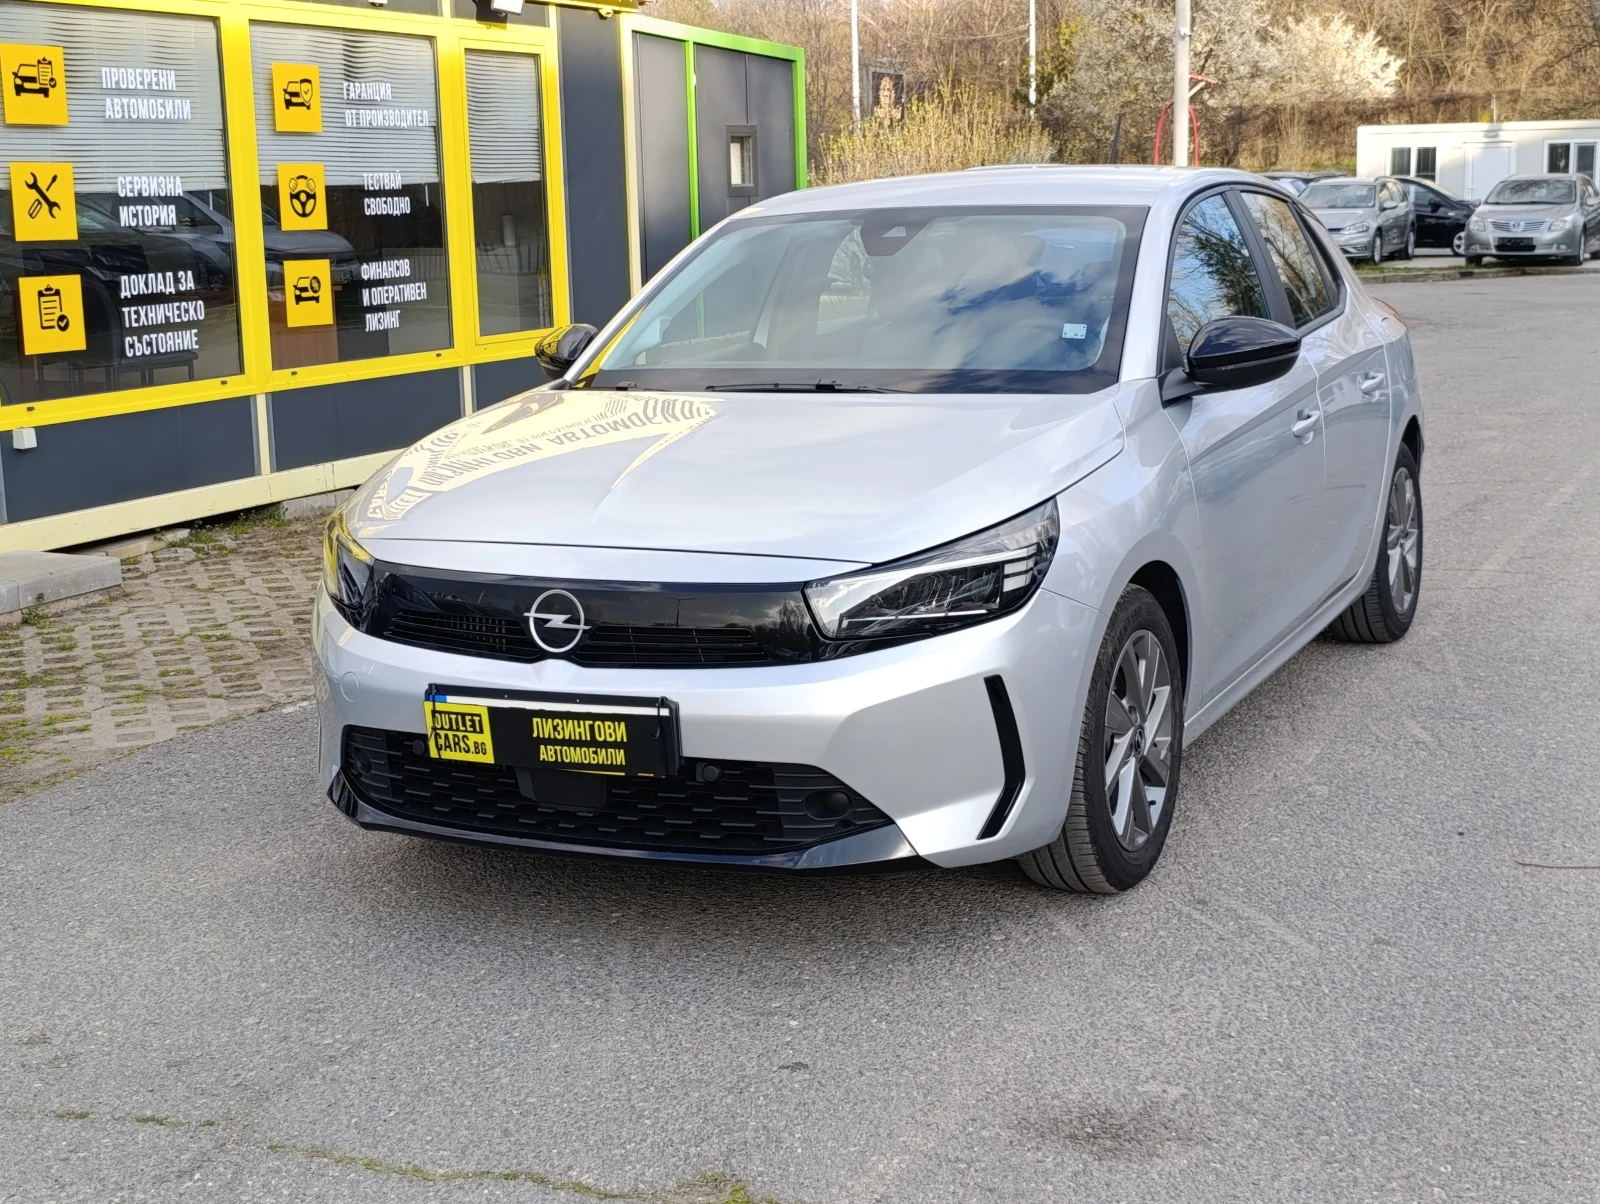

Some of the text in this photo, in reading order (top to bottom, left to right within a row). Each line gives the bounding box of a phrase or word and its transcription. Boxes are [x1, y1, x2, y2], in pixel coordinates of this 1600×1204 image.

[101, 67, 177, 91] ПРОВЕРЕНИ
[343, 82, 392, 102] ГАРАНЦИЯ
[105, 97, 192, 120] АВТОМОБИЛИ
[345, 109, 429, 129] ОТ ПРОИЗВОДИТЕЛ
[117, 176, 183, 198] СЕРВИЗНА
[363, 169, 402, 191] ТЕСТВАЙ
[119, 204, 177, 227] ИСТОРИЯ
[364, 196, 411, 217] СВОБОДНО
[361, 258, 411, 282] ФИНАНСОВ
[120, 271, 195, 299] ДОКЛАД ЗА
[363, 282, 428, 307] И ОПЕРАТИВЕН
[122, 300, 205, 328] ТЕХНИЧЕСКО
[365, 309, 401, 332] ЛИЗИНГ
[124, 329, 199, 358] СЪСТОЯНИЕ
[434, 712, 481, 733] OUTLET
[532, 717, 627, 743] ЛИЗИНГОВИ
[435, 732, 487, 756] CARS.BG
[540, 744, 626, 766] АВТОМОБИЛИ
